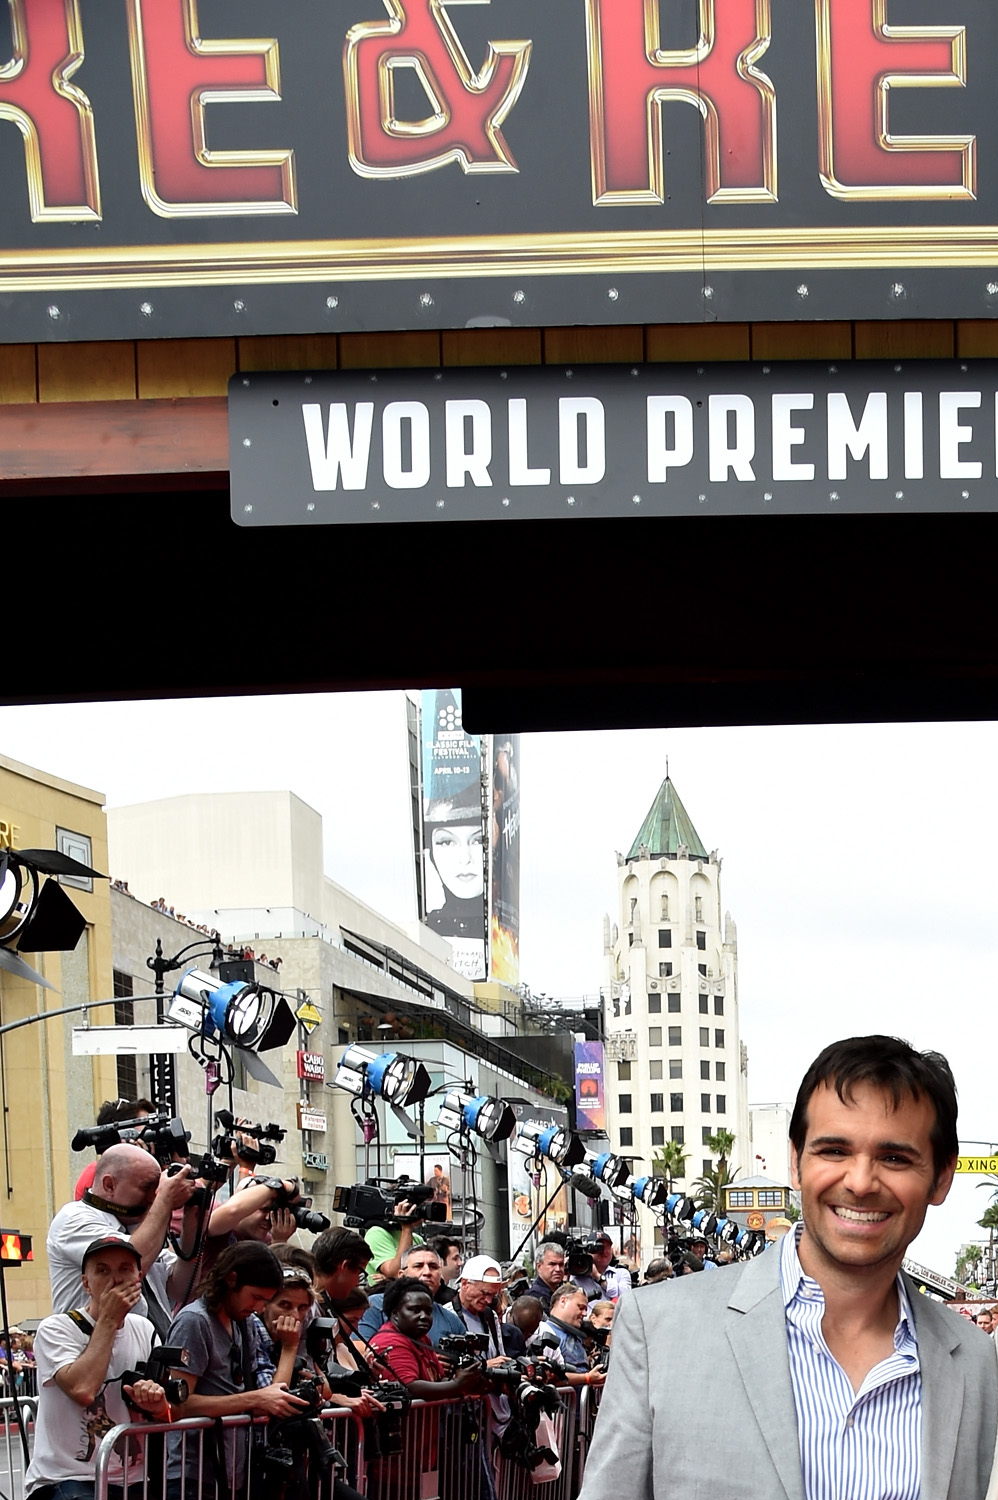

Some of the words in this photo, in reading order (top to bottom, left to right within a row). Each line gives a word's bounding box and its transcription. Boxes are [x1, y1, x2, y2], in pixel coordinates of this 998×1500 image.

[302, 396, 606, 492] WORLD
[433, 748, 469, 756] FESTIVAL
[434, 767, 453, 775] APRIL
[303, 1053, 324, 1066] CABO
[303, 1062, 325, 1075] WABO
[967, 1159, 997, 1171] XING
[921, 1268, 929, 1278] LOS
[930, 1273, 947, 1287] ANGELES
